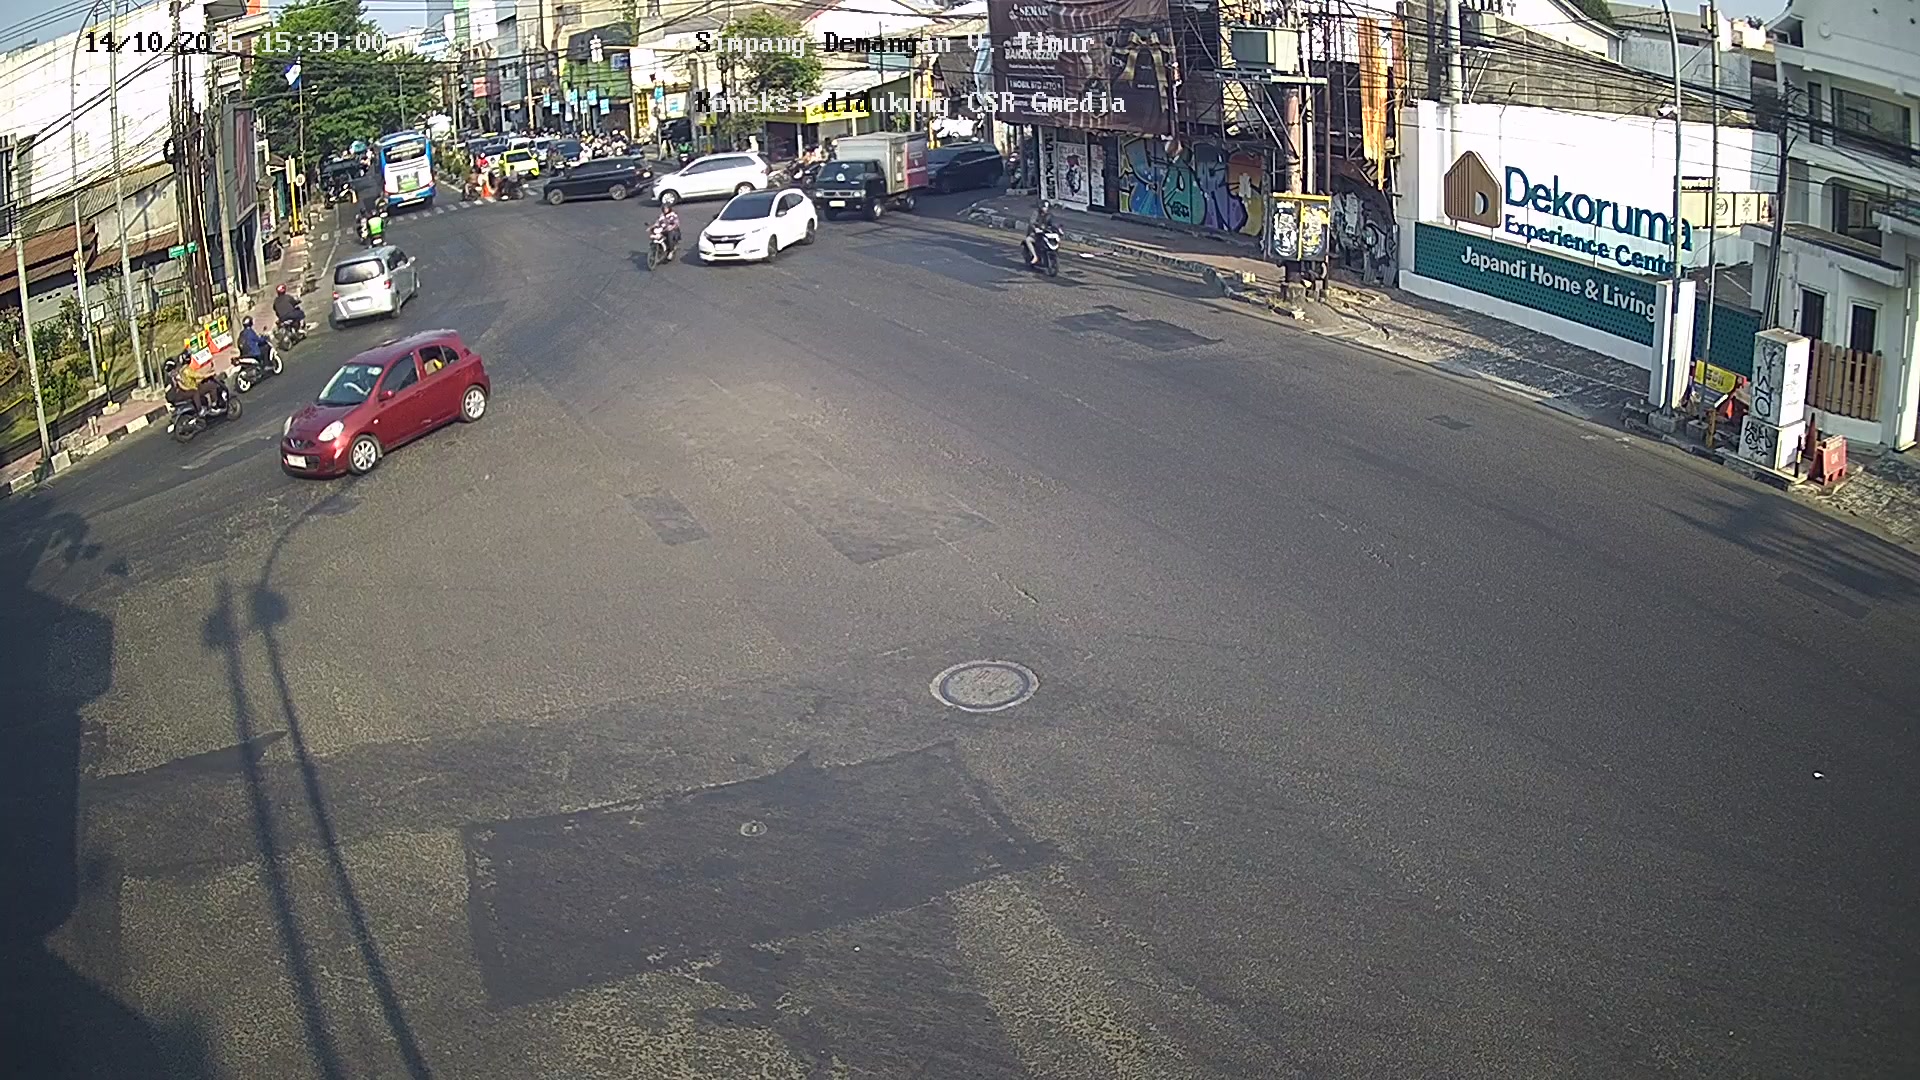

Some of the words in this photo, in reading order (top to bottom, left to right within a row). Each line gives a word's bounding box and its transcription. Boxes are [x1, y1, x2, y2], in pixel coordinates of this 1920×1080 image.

[1504, 165, 1692, 252] Dekoruma
[1504, 213, 1610, 260] Experience
[1614, 244, 1681, 277] Cente
[1460, 245, 1527, 280] Japandi
[1529, 262, 1582, 295] Home
[1584, 278, 1599, 301] &
[1602, 283, 1656, 323] Living
